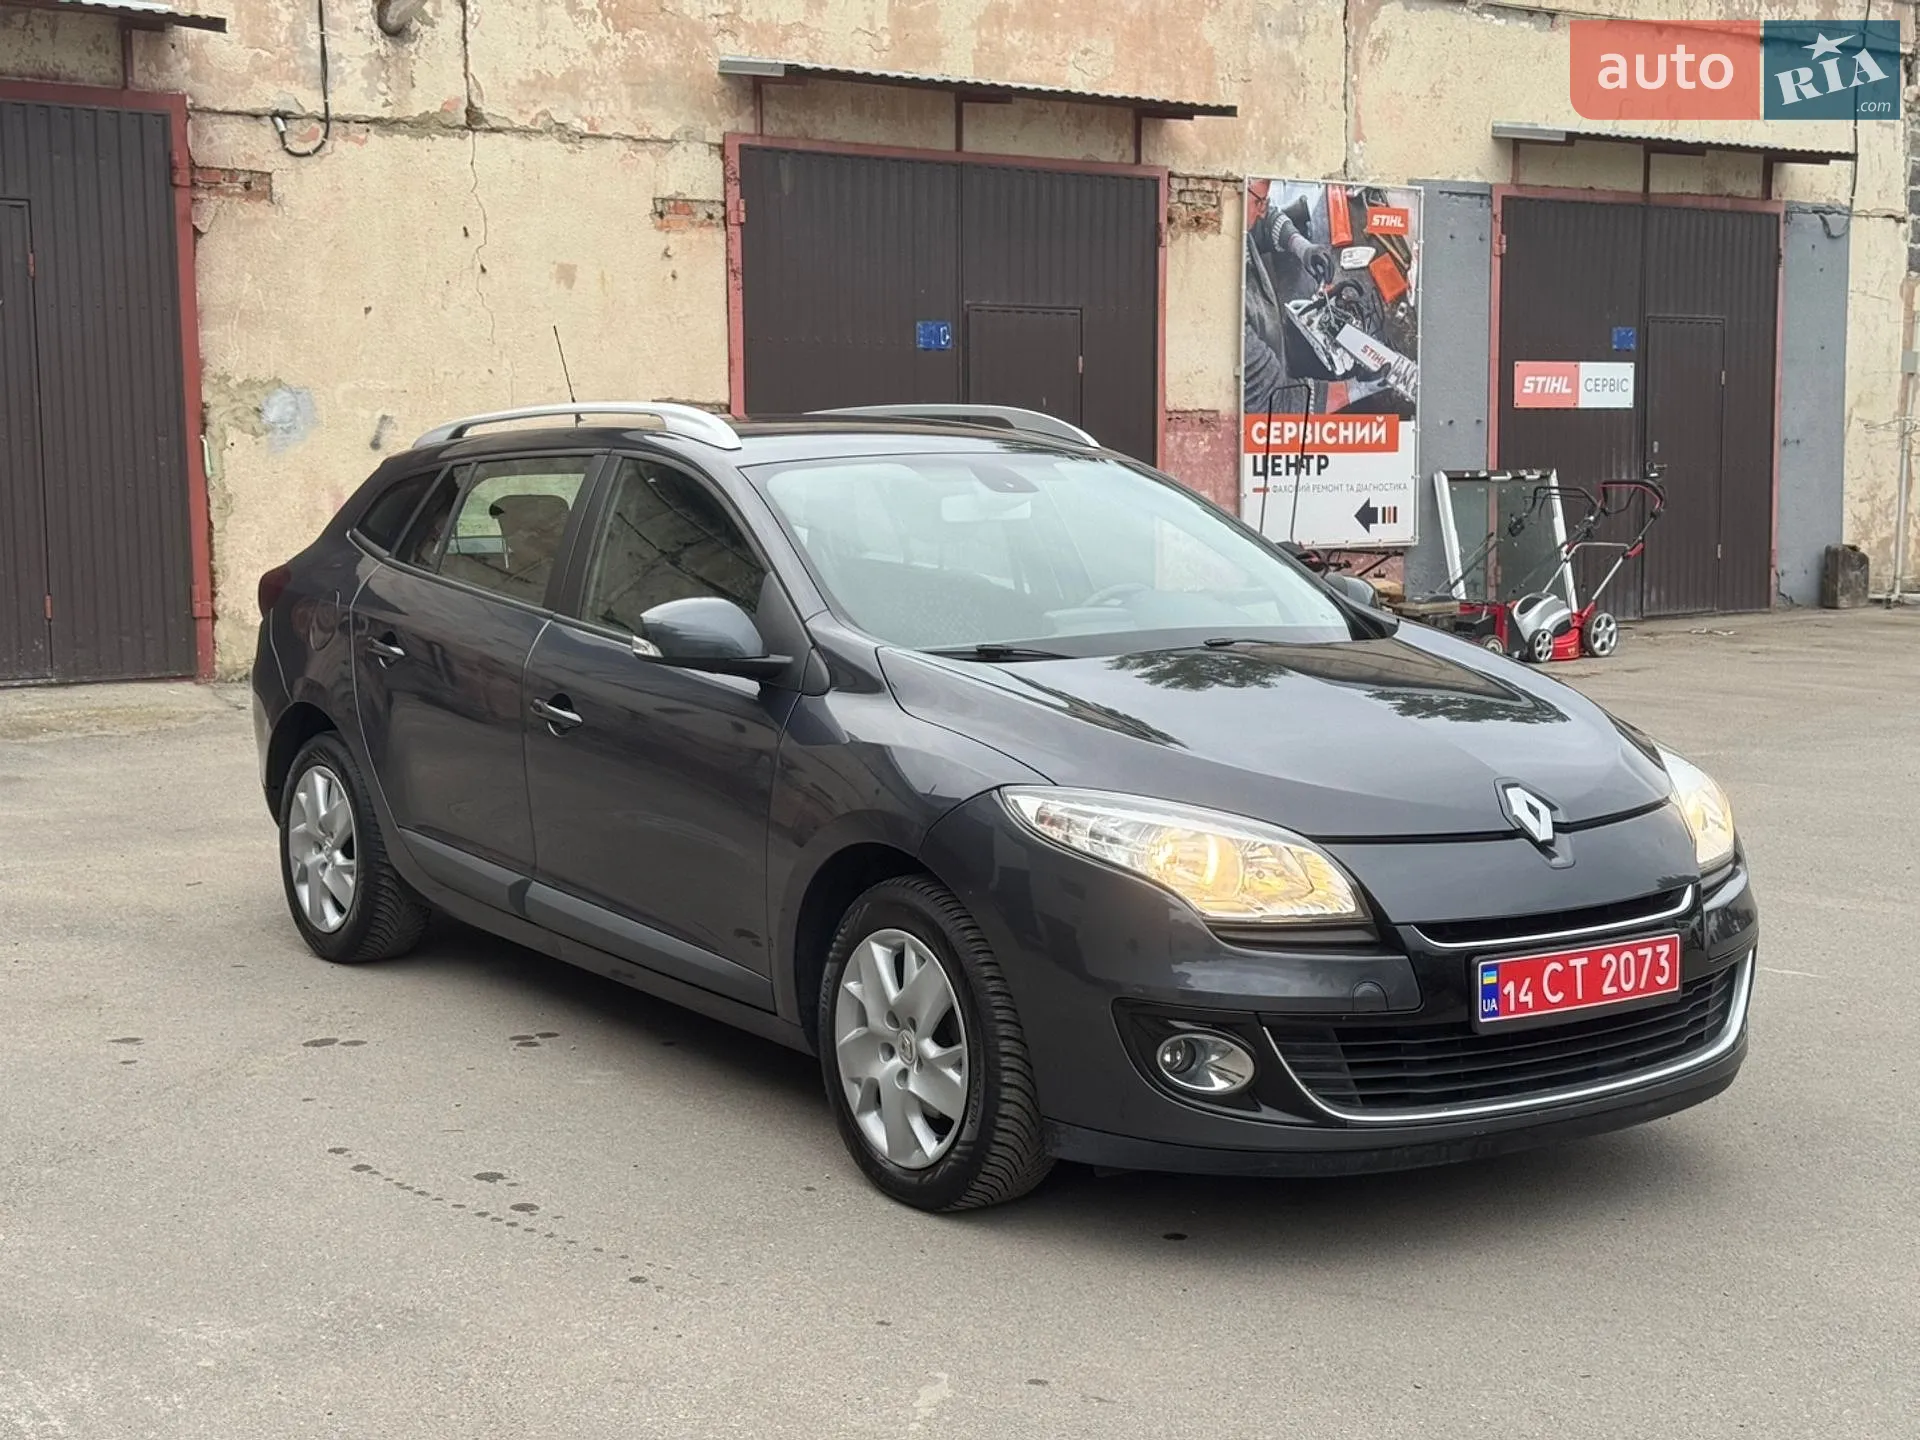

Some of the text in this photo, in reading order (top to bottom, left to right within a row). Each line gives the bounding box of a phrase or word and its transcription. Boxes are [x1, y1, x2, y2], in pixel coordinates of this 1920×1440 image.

[1371, 214, 1405, 228] STIHL
[1361, 344, 1386, 367] STIHL
[1522, 376, 1629, 394] STIHL СЕРВІС
[1251, 416, 1387, 445] СЕРВІСНИЙ
[1252, 455, 1329, 476] ЦЕНТР
[1312, 484, 1343, 493] РЕМОНТ
[1503, 944, 1670, 1011] 14 CT 2073
[1482, 999, 1498, 1012] UA
